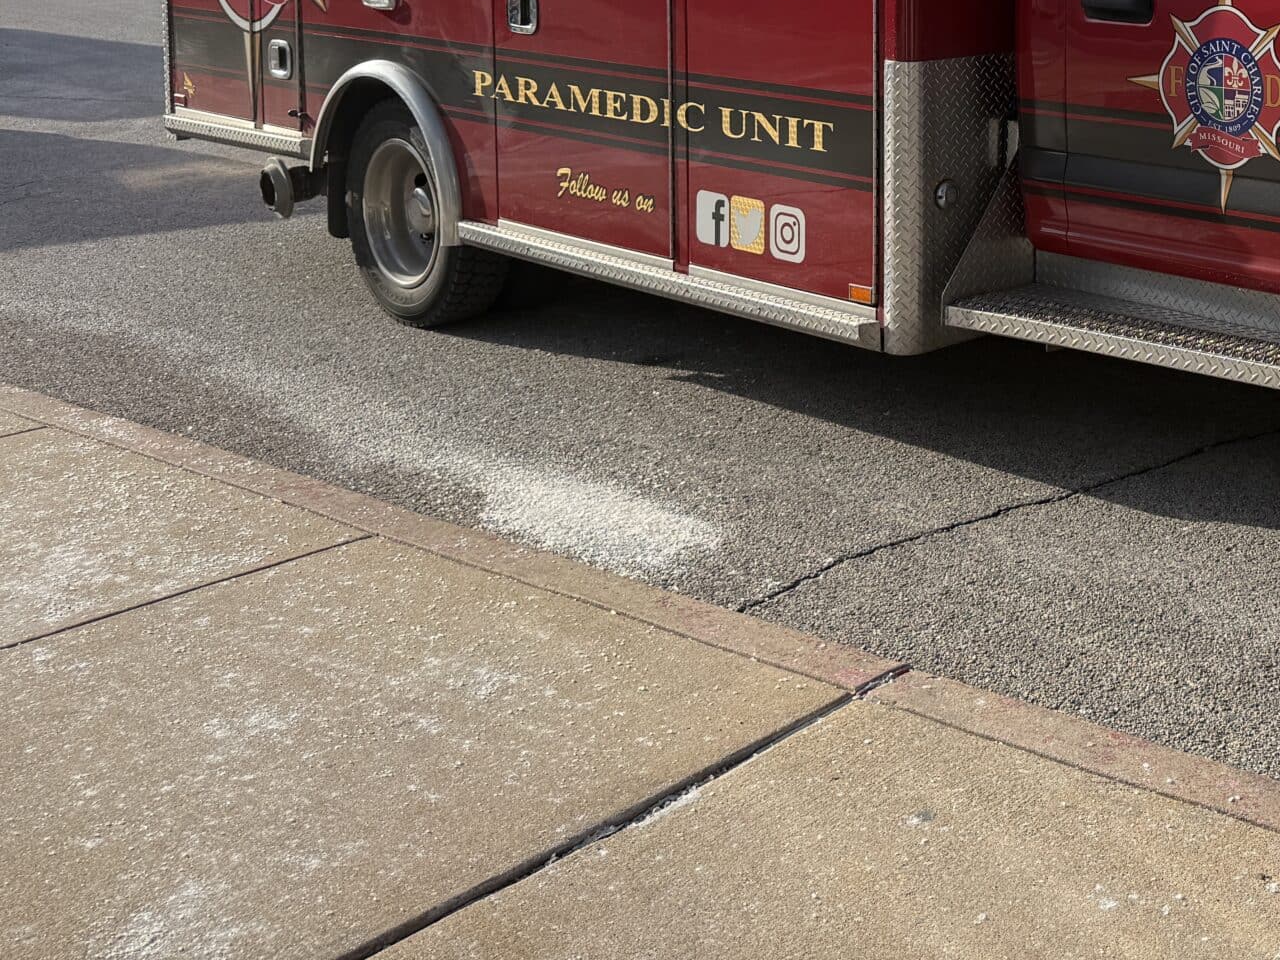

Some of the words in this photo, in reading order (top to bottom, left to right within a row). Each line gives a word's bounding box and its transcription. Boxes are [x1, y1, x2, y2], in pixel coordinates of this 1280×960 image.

[1189, 54, 1202, 74] OF
[1201, 40, 1240, 58] SAINT
[1168, 66, 1184, 97] F
[1186, 79, 1202, 115] CITY
[1241, 52, 1262, 122] CHARLES
[472, 70, 705, 132] PARAMEDIC
[719, 106, 834, 152] UNIT
[1199, 132, 1245, 154] MISSOURI
[556, 167, 608, 203] Follow
[611, 189, 631, 208] us
[635, 194, 656, 214] on
